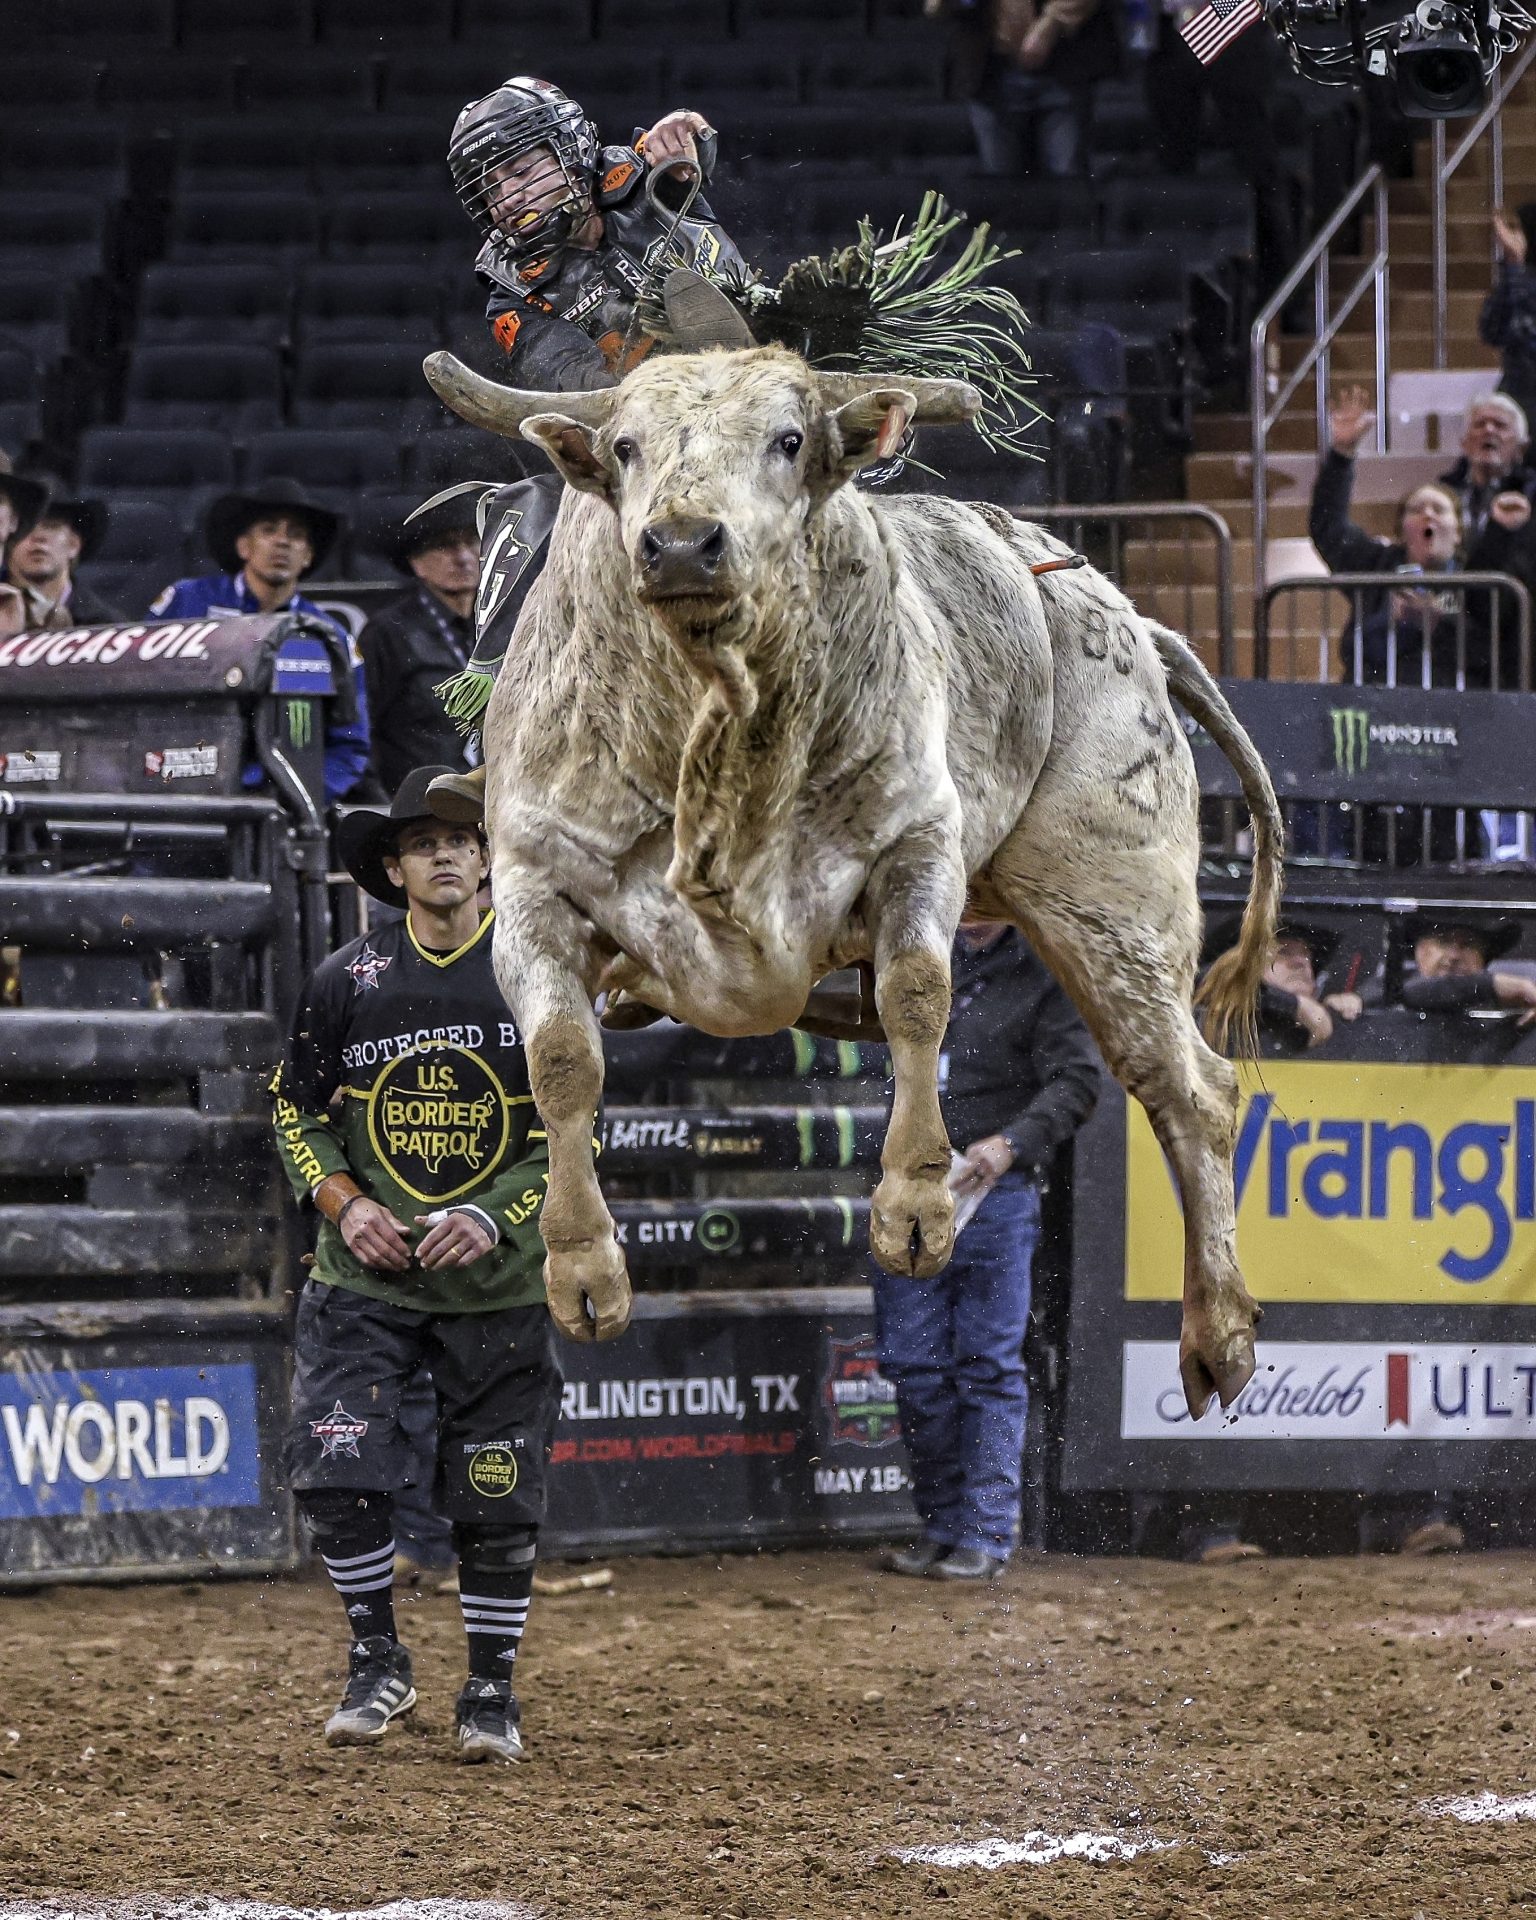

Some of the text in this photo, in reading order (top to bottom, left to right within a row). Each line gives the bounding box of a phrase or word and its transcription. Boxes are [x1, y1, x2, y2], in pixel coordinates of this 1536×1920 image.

[462, 131, 497, 157] BAUER
[0, 621, 220, 667] LUCAS OIL
[1369, 724, 1459, 747] MONSTER
[341, 1022, 525, 1069] PROTECTED B
[417, 1065, 458, 1091] U.S.
[386, 1101, 489, 1129] BORDER
[389, 1130, 485, 1158] PATROL
[610, 1118, 691, 1150] BATTLE
[284, 1126, 327, 1188] PATR
[503, 1188, 543, 1225] U.S.
[637, 1219, 696, 1244] CITY
[560, 1375, 747, 1421] RLINGTON,
[751, 1373, 800, 1414] TX
[1431, 1363, 1536, 1418] ULT
[1, 1396, 230, 1486] WORLD
[474, 1463, 512, 1475] BORDER
[474, 1472, 512, 1485] PATROL
[813, 1465, 868, 1495] MAY
